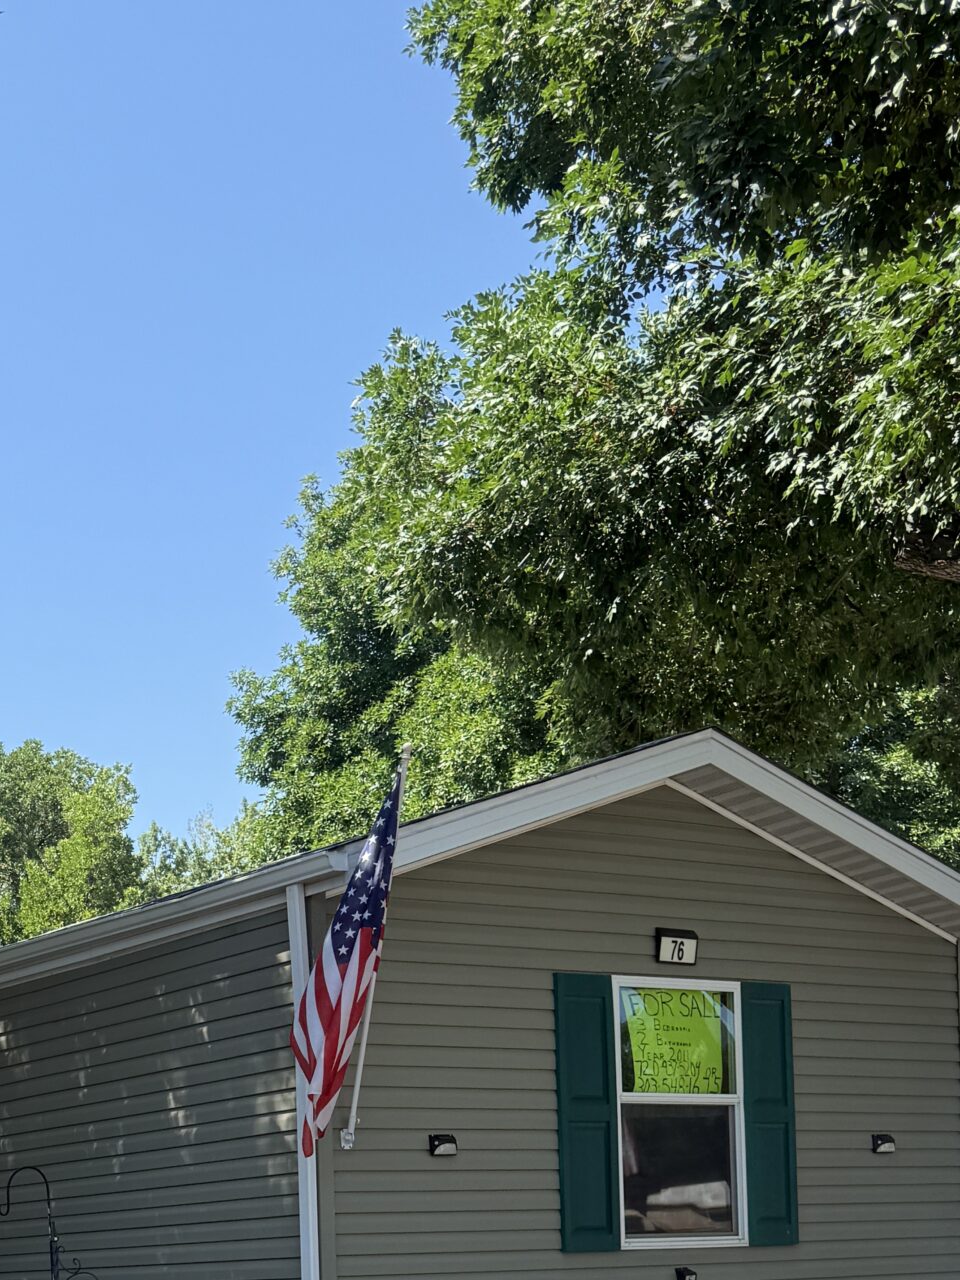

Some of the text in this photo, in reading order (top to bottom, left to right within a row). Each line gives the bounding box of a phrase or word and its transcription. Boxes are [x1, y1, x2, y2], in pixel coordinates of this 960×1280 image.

[671, 940, 684, 960] 76
[628, 992, 720, 1018] FOR SALE
[636, 1017, 647, 1031] 3
[636, 1031, 650, 1046] 2
[637, 1044, 665, 1061] YEAR
[705, 1067, 717, 1077] OR
